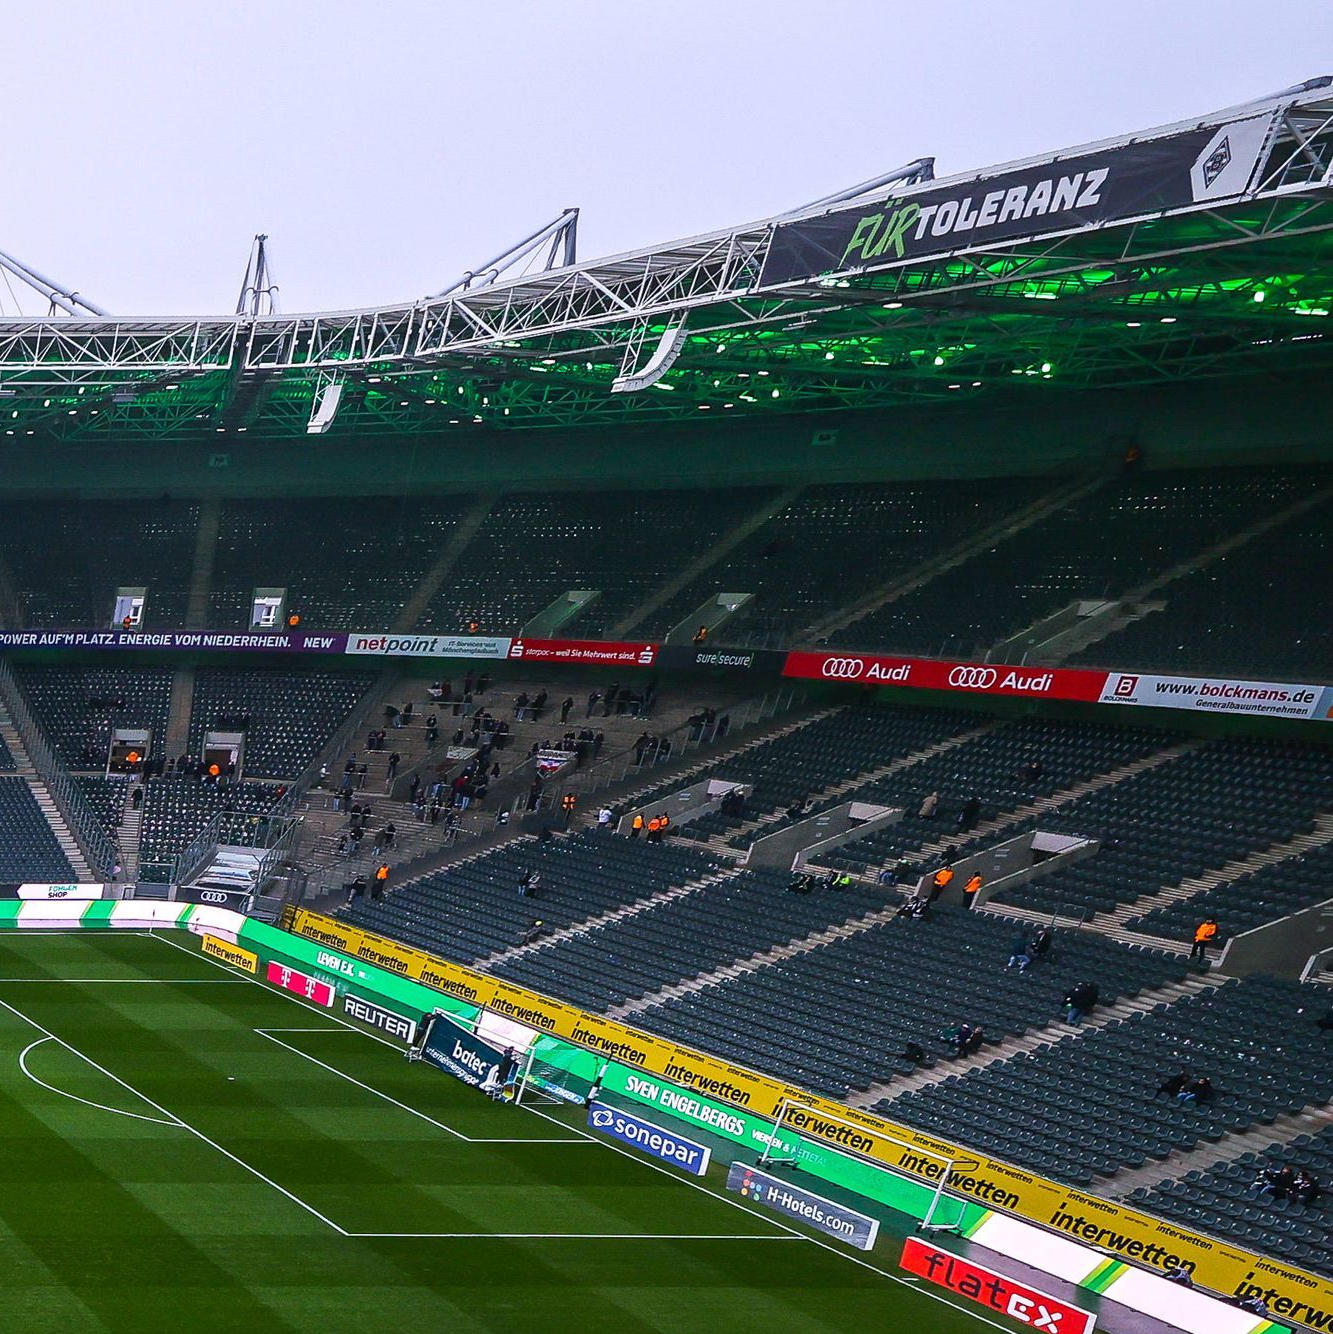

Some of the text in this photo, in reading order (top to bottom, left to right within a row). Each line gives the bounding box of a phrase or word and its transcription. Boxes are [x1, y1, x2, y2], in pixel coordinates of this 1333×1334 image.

[39, 634, 75, 645] AUF'M
[76, 635, 117, 646] PLATZ.
[119, 633, 173, 646] ENERGIE
[175, 634, 202, 646] VOM
[202, 635, 292, 648] NIEDERRHEIN.
[303, 637, 335, 649] NEW
[355, 636, 438, 655] netpoint
[555, 648, 571, 657] weil
[570, 648, 582, 658] Sie
[582, 650, 618, 660] Mehrwert
[618, 651, 636, 661] sind.
[695, 650, 755, 668] sure[secure]
[866, 662, 911, 681] Audi
[999, 671, 1055, 692] Audi
[1155, 681, 1315, 705] www.bolckmans.de
[1195, 698, 1310, 717] Generalbauunternehmen
[47, 891, 68, 900] SHOP
[48, 884, 78, 894] FOHLEN
[204, 936, 254, 970] interwetten
[316, 951, 340, 972] LEVEN
[356, 940, 408, 974] interwetten
[344, 999, 408, 1041] REUTER
[489, 989, 557, 1031] interwetten
[452, 1040, 489, 1076] batec
[570, 1020, 648, 1067] interwetten
[662, 1054, 752, 1107] interwetten
[624, 1074, 663, 1102] SVEN
[659, 1084, 746, 1139] ENGELBERGS
[770, 1095, 874, 1154] interwetten
[613, 1117, 700, 1168] sonepar
[896, 1147, 1020, 1209] interwetten
[765, 1186, 855, 1237] H-Hotels.com
[1049, 1201, 1198, 1276] interwetten
[1155, 1220, 1214, 1253] interwetten
[1254, 1257, 1319, 1290] interwetten
